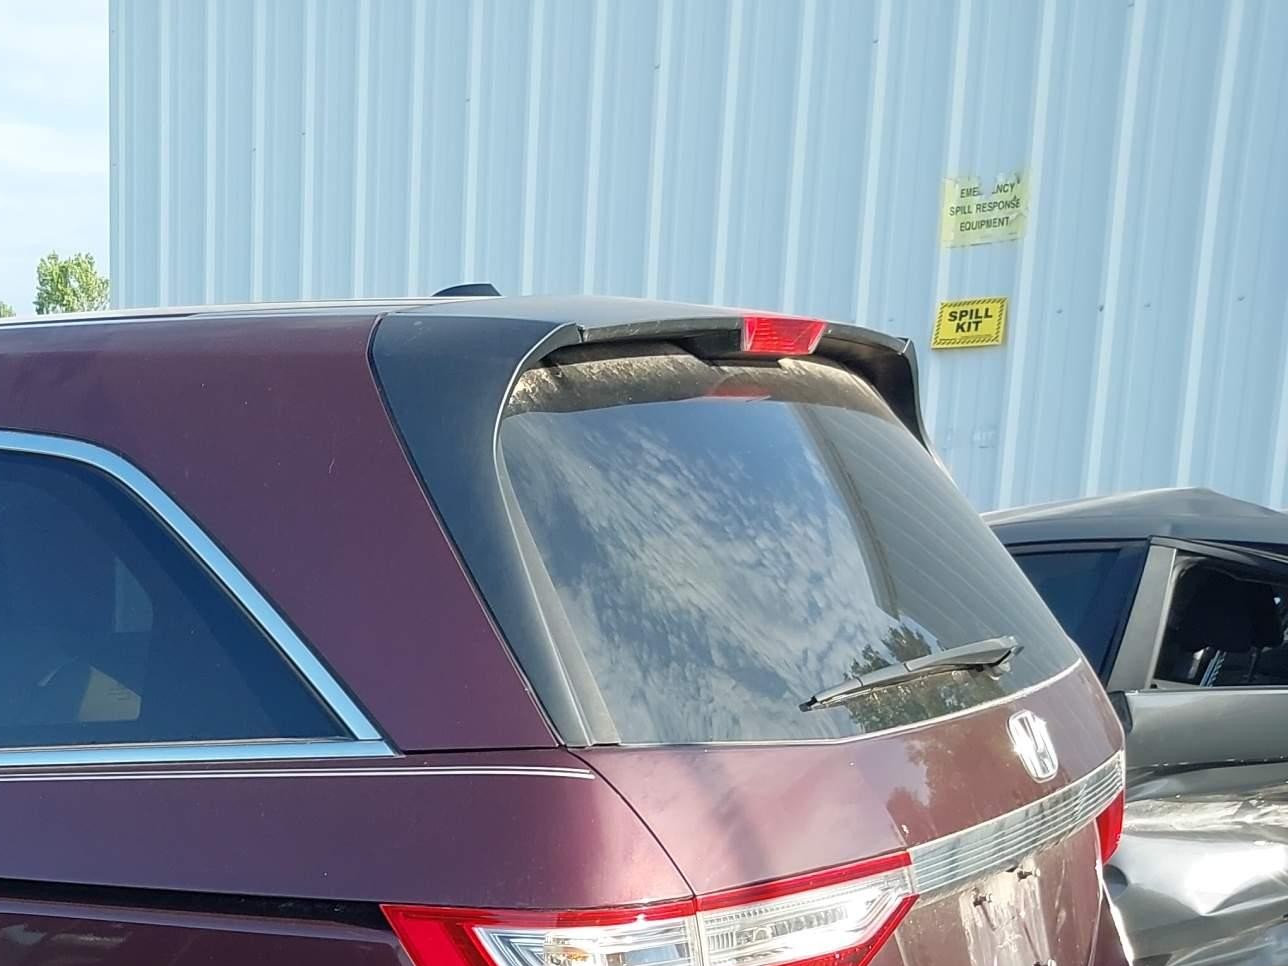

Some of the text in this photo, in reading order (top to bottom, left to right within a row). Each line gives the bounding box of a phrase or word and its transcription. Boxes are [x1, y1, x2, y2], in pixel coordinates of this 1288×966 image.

[960, 183, 1015, 198] EMENCY
[949, 198, 1020, 216] SPILL RESPONSE
[959, 216, 1010, 232] EQUIPMENT
[948, 307, 993, 322] SPILL
[955, 320, 983, 333] KIT
